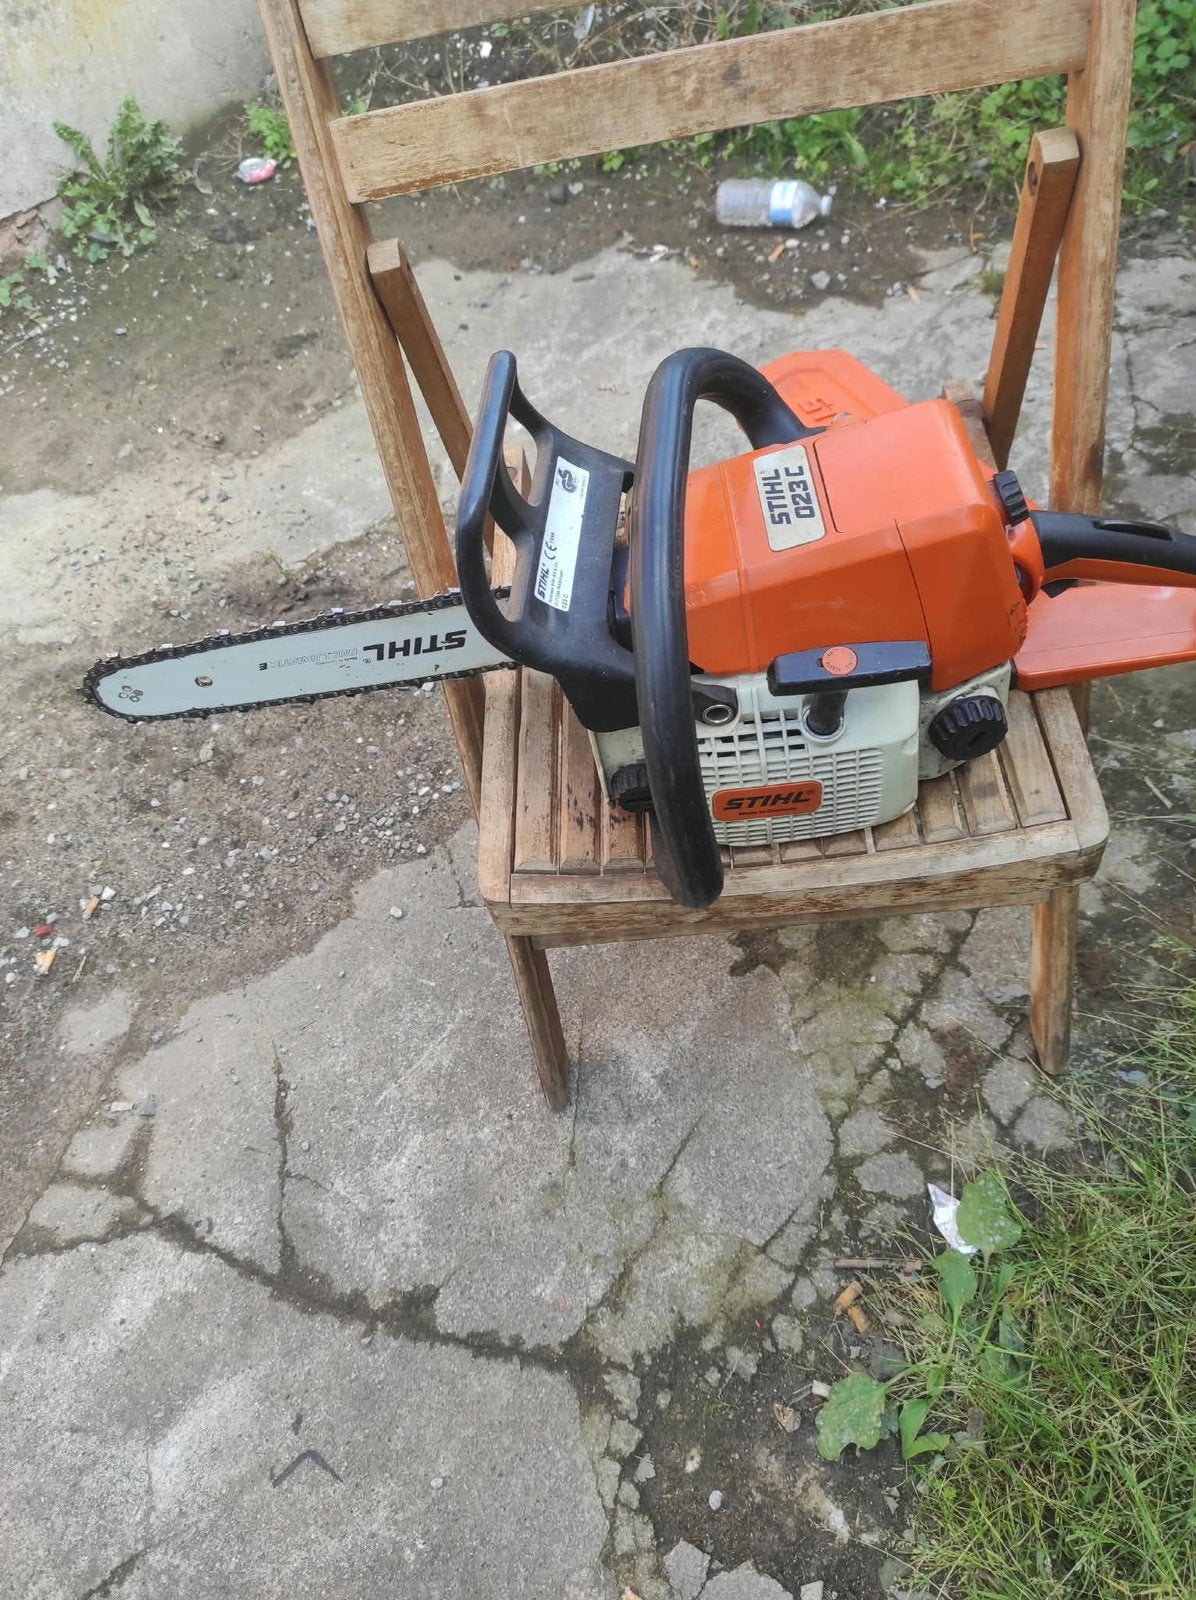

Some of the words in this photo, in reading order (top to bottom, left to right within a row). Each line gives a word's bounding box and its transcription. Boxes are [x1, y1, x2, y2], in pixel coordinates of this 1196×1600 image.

[762, 469, 792, 525] STIHL
[537, 566, 550, 600] STIHL
[363, 629, 467, 661] STIHL
[723, 791, 811, 811] STIHL
